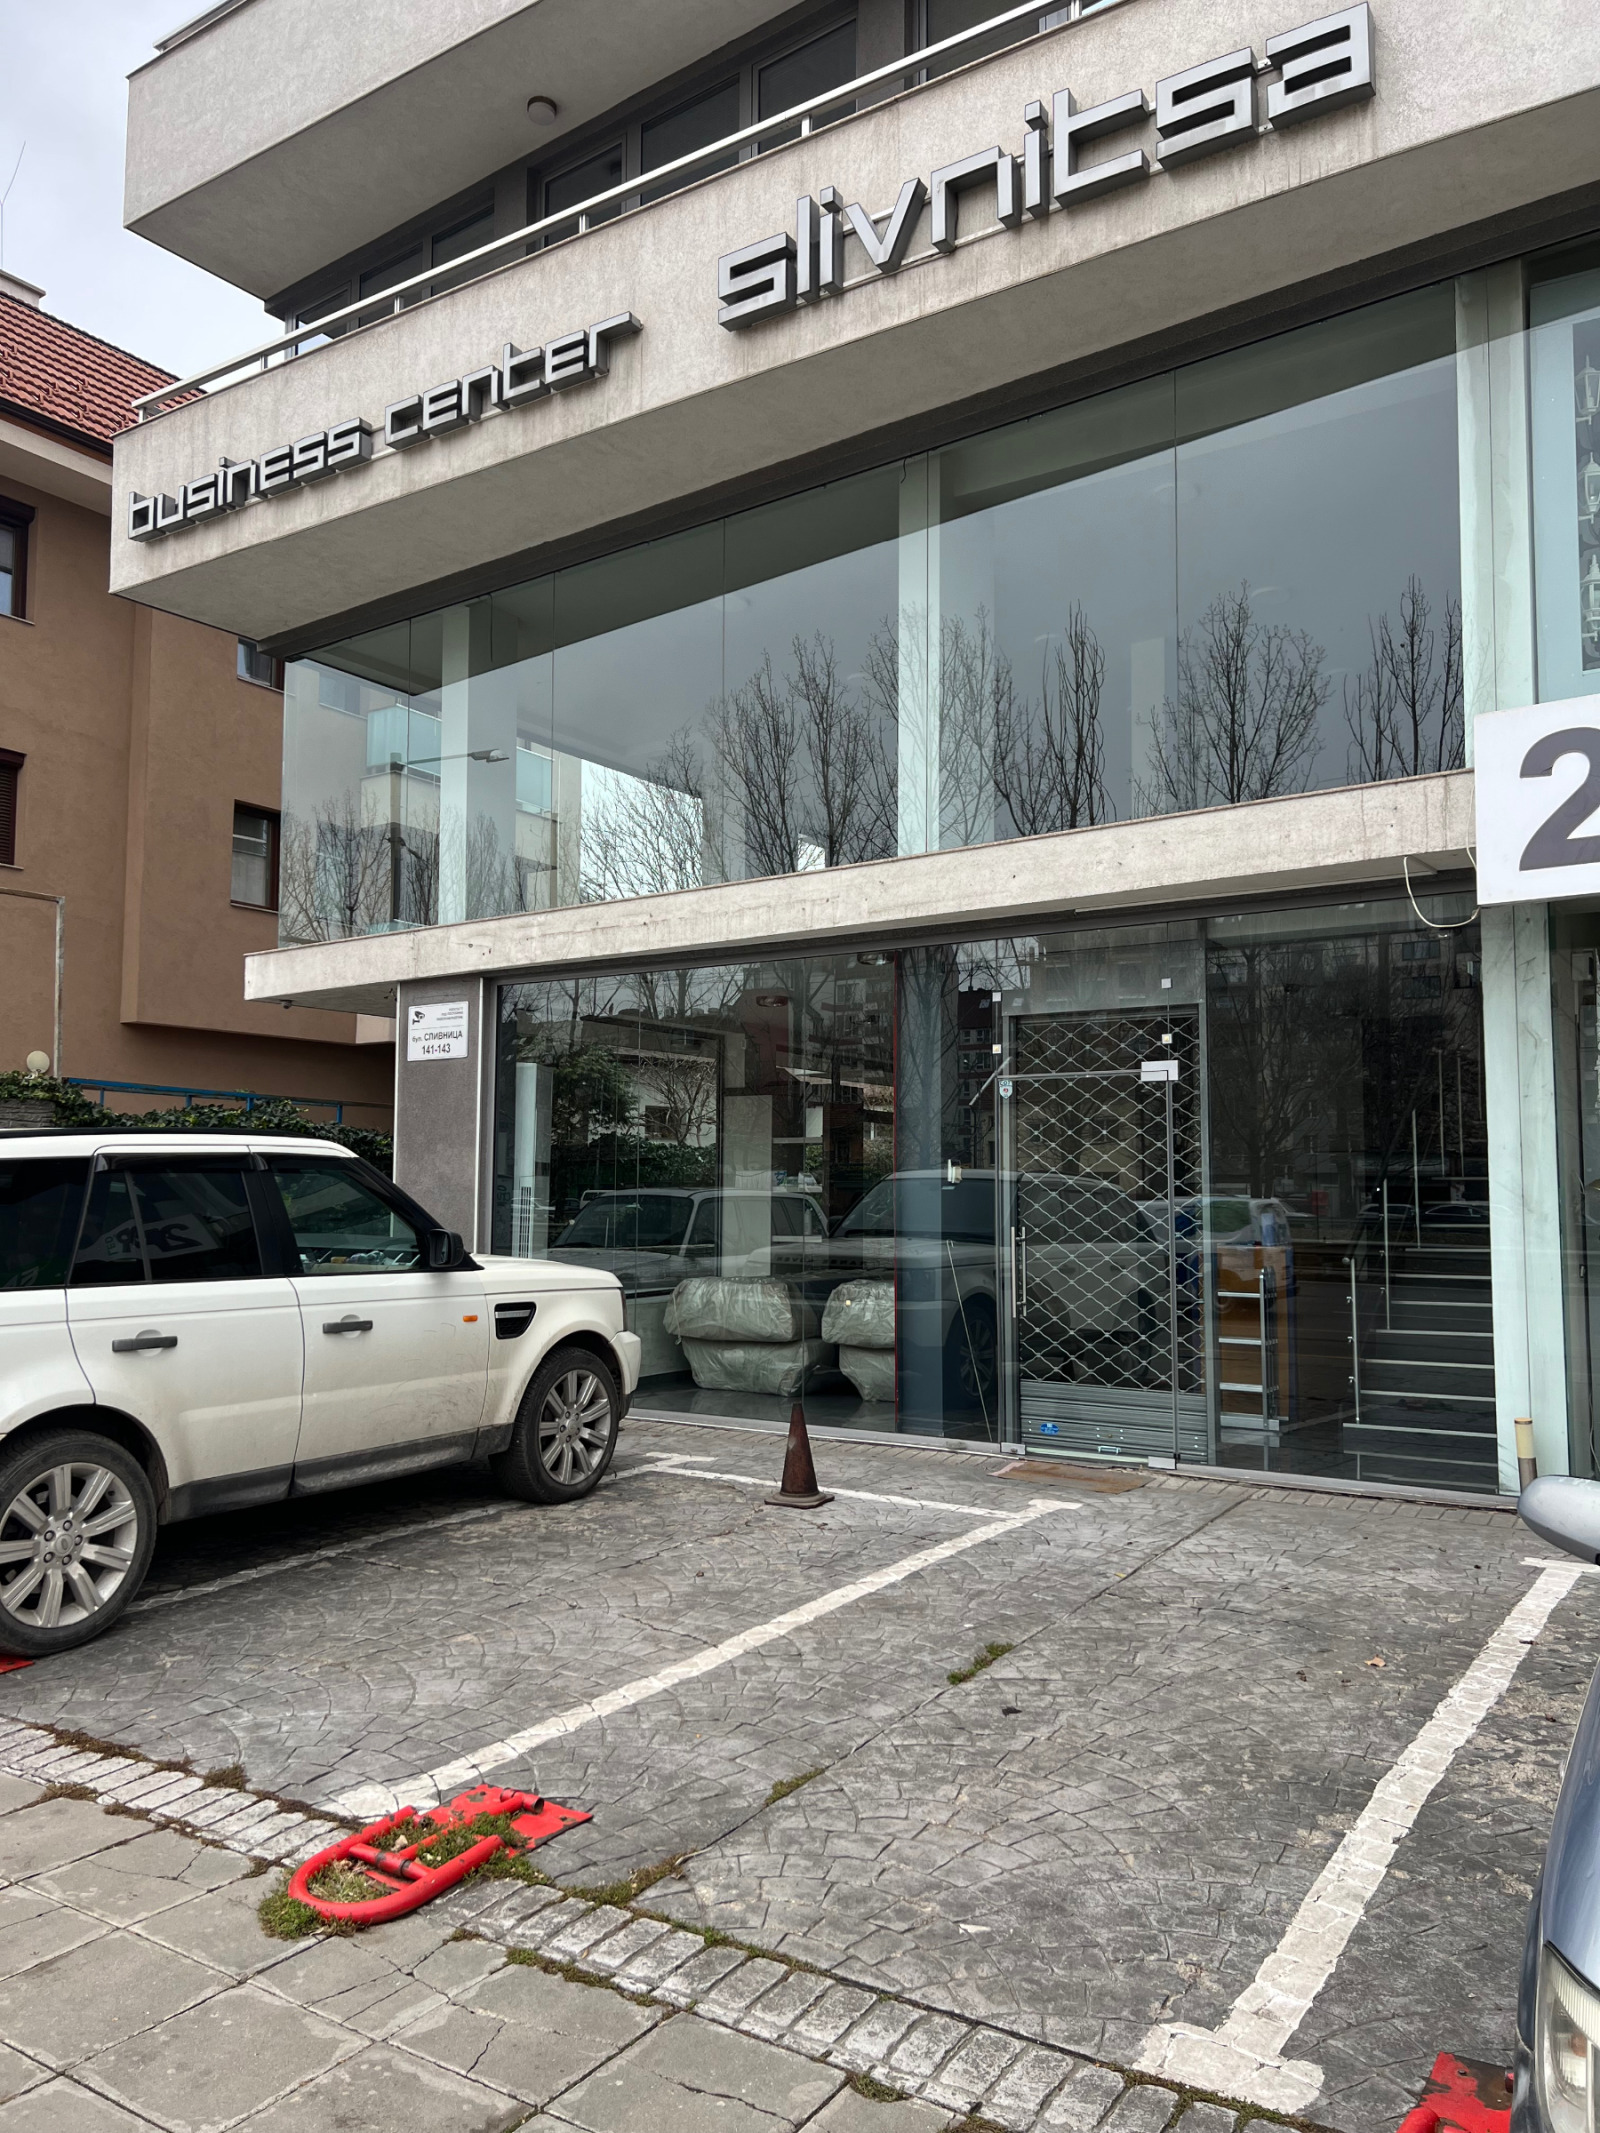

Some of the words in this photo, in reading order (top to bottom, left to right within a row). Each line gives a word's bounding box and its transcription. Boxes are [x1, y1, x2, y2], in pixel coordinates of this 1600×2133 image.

[718, 1, 1375, 332] slivnitsa
[128, 416, 372, 542] business
[384, 311, 643, 450] center
[422, 1043, 451, 1054] 141-143
[424, 1030, 463, 1041] СЛИВНИЦА
